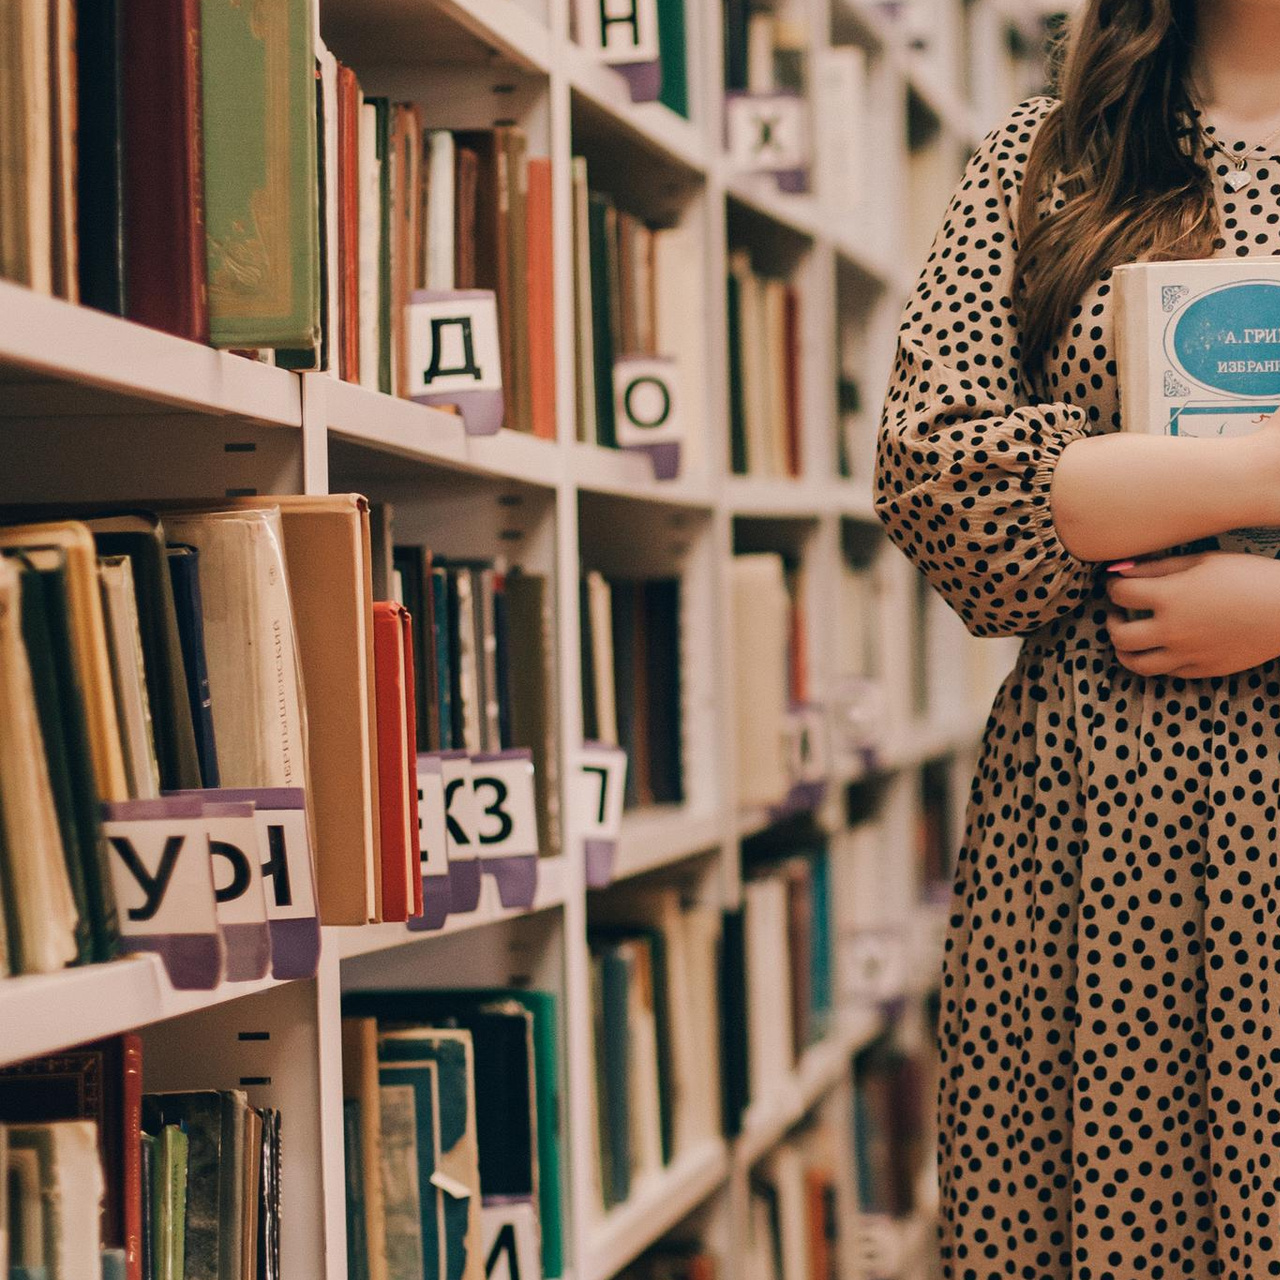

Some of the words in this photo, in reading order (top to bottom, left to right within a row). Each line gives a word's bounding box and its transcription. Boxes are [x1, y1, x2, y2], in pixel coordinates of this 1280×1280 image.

[424, 316, 482, 384] Д
[623, 375, 672, 429] О
[472, 775, 514, 845] З
[109, 836, 185, 922] У
